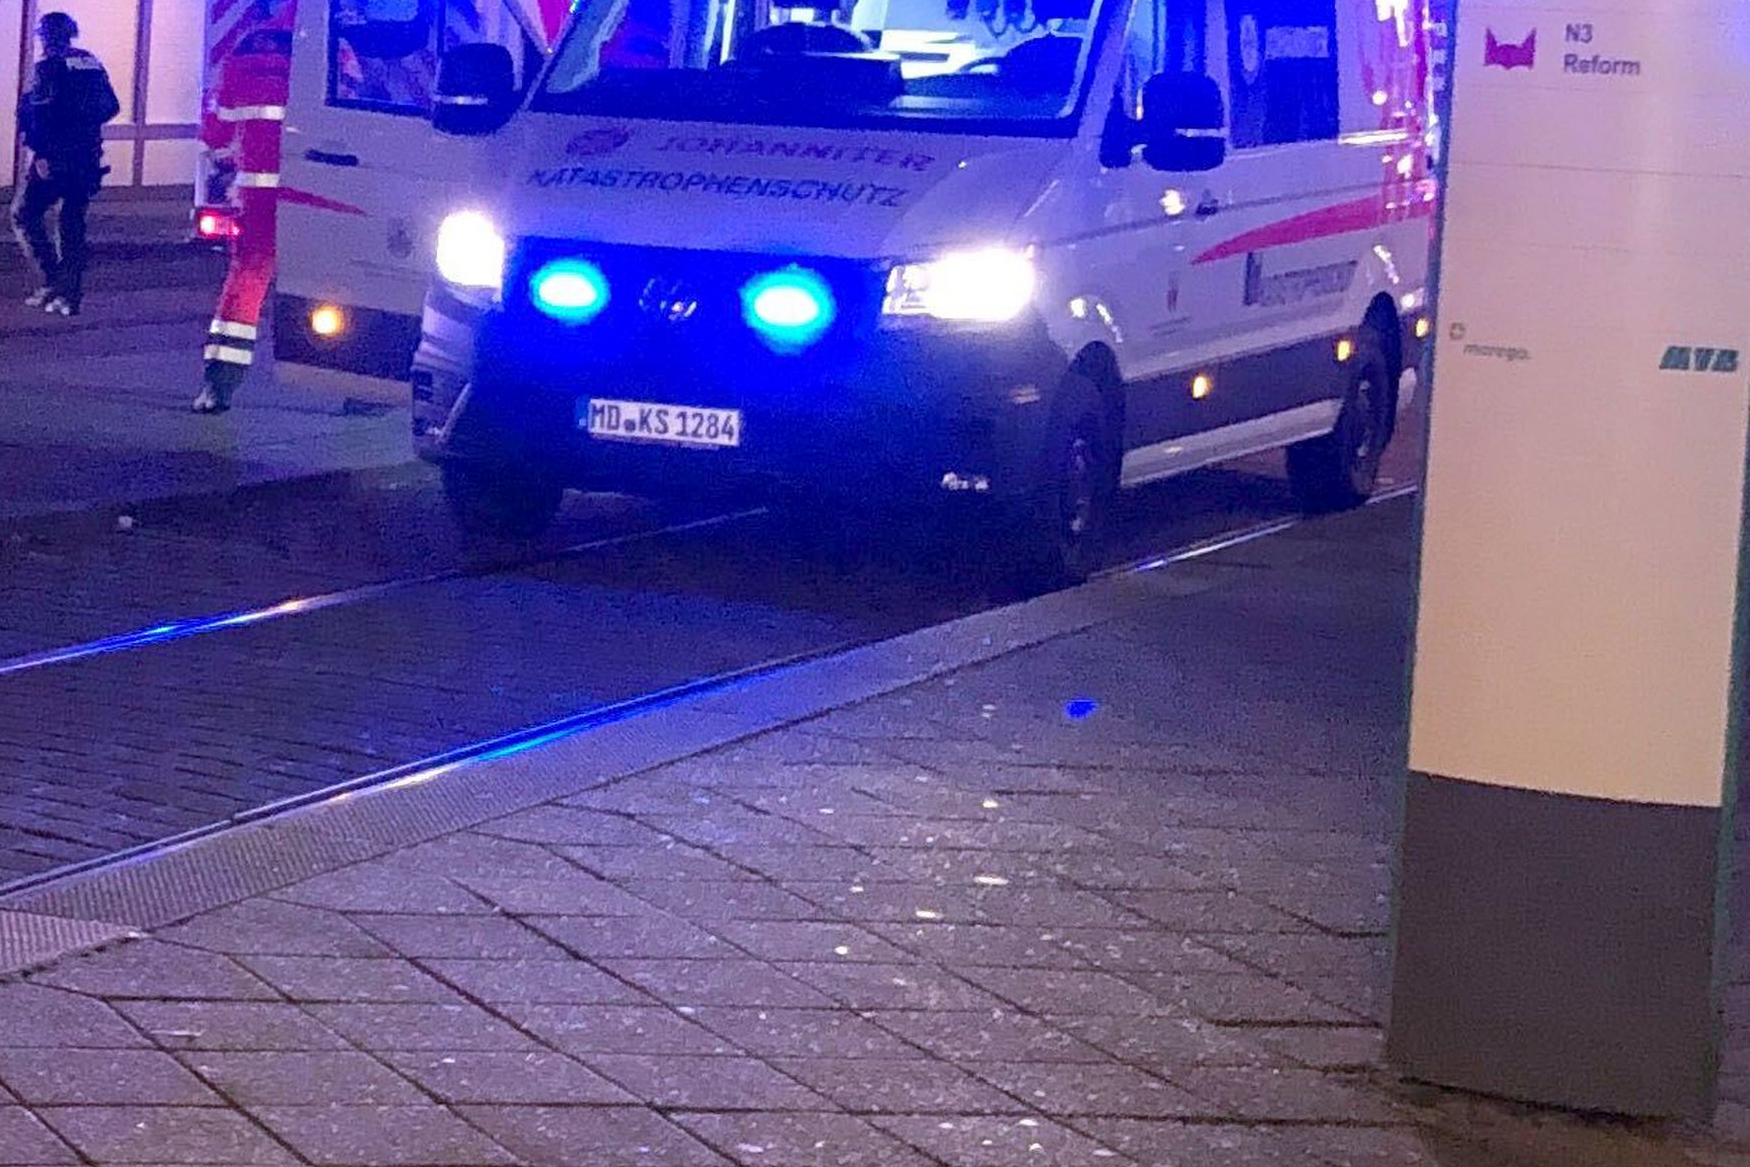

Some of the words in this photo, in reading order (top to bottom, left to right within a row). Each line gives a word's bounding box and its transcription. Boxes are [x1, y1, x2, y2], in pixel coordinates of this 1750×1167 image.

[1565, 24, 1593, 44] N3
[1563, 53, 1641, 76] Reform
[655, 136, 935, 172] JOHANNITER
[525, 166, 908, 208] KATASTROPHENSCHUTZ
[590, 402, 621, 432] MD
[639, 407, 669, 435] KS
[675, 411, 735, 440] 1284
